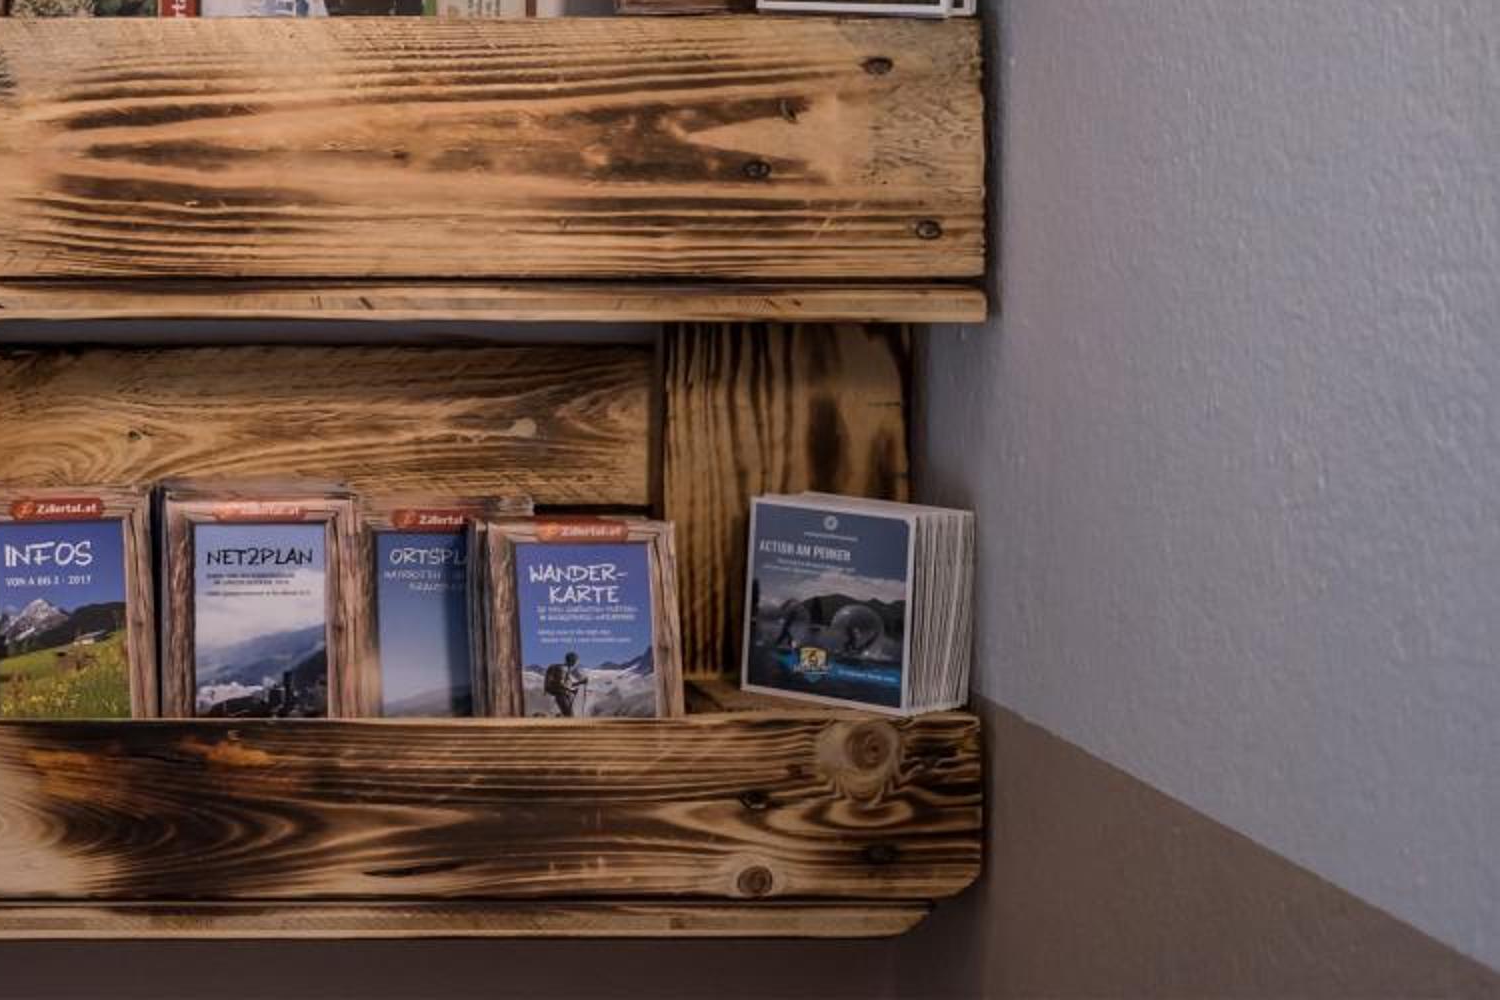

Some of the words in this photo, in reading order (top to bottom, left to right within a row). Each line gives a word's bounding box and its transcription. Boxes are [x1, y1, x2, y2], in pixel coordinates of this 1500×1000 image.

[35, 503, 97, 514] Zillertal.at
[4, 541, 93, 567] INFOS
[529, 563, 629, 583] WANDER-
[549, 585, 621, 604] KARTE
